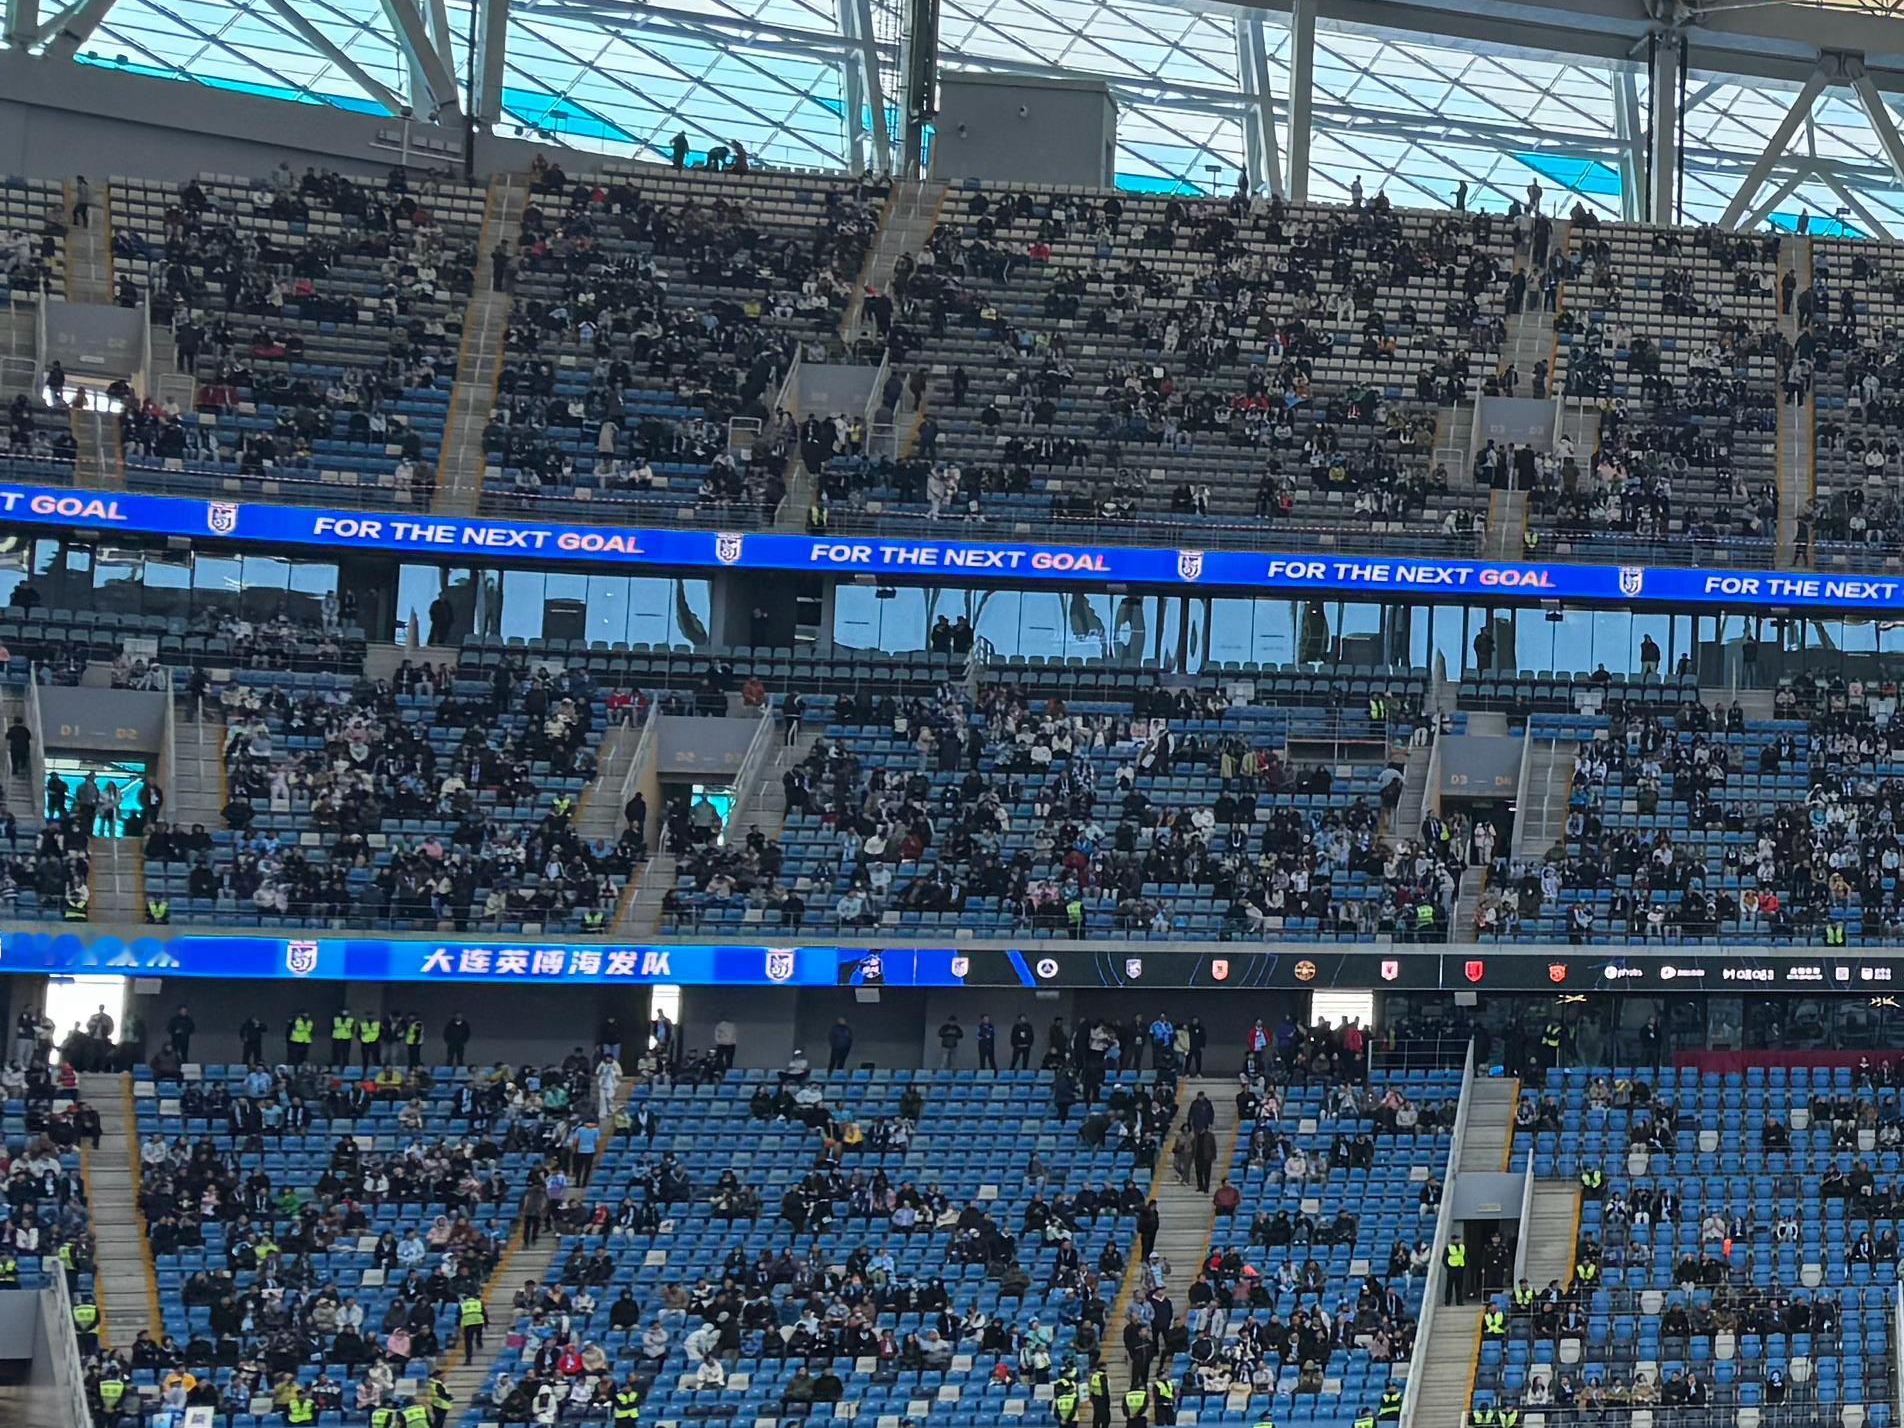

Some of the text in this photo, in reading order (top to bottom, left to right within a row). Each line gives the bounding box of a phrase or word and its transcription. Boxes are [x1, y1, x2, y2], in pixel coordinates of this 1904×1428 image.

[31, 496, 126, 520] GOAL
[312, 518, 644, 555] FOR THE NEXT GOAL
[811, 545, 1110, 571] FOR THE NEXT GOAL
[1268, 561, 1554, 588] FOR THE NEXT GOAL
[1706, 578, 1759, 594] FOR
[1767, 580, 1819, 596] THE
[1826, 582, 1897, 599] NEXT
[115, 728, 140, 740] D2
[423, 950, 670, 975] 大连英博海发队
